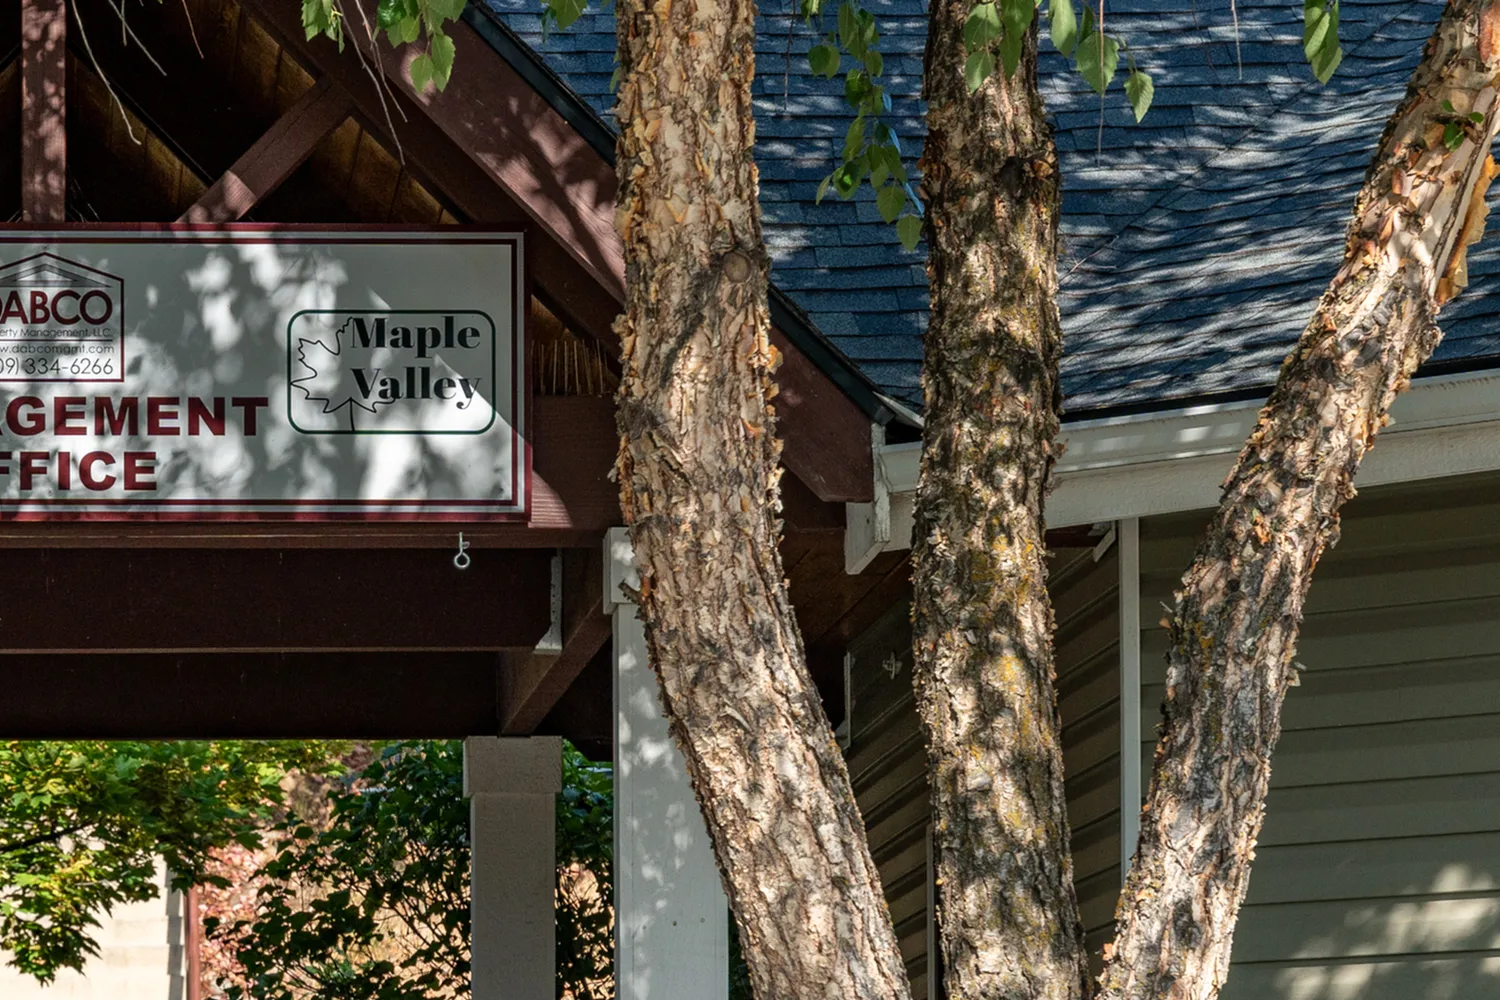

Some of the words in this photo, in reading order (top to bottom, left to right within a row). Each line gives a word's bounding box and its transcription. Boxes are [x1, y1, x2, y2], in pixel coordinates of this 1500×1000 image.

[350, 315, 481, 359] Maple
[24, 357, 114, 376] 334-6266
[351, 366, 482, 410] Valley
